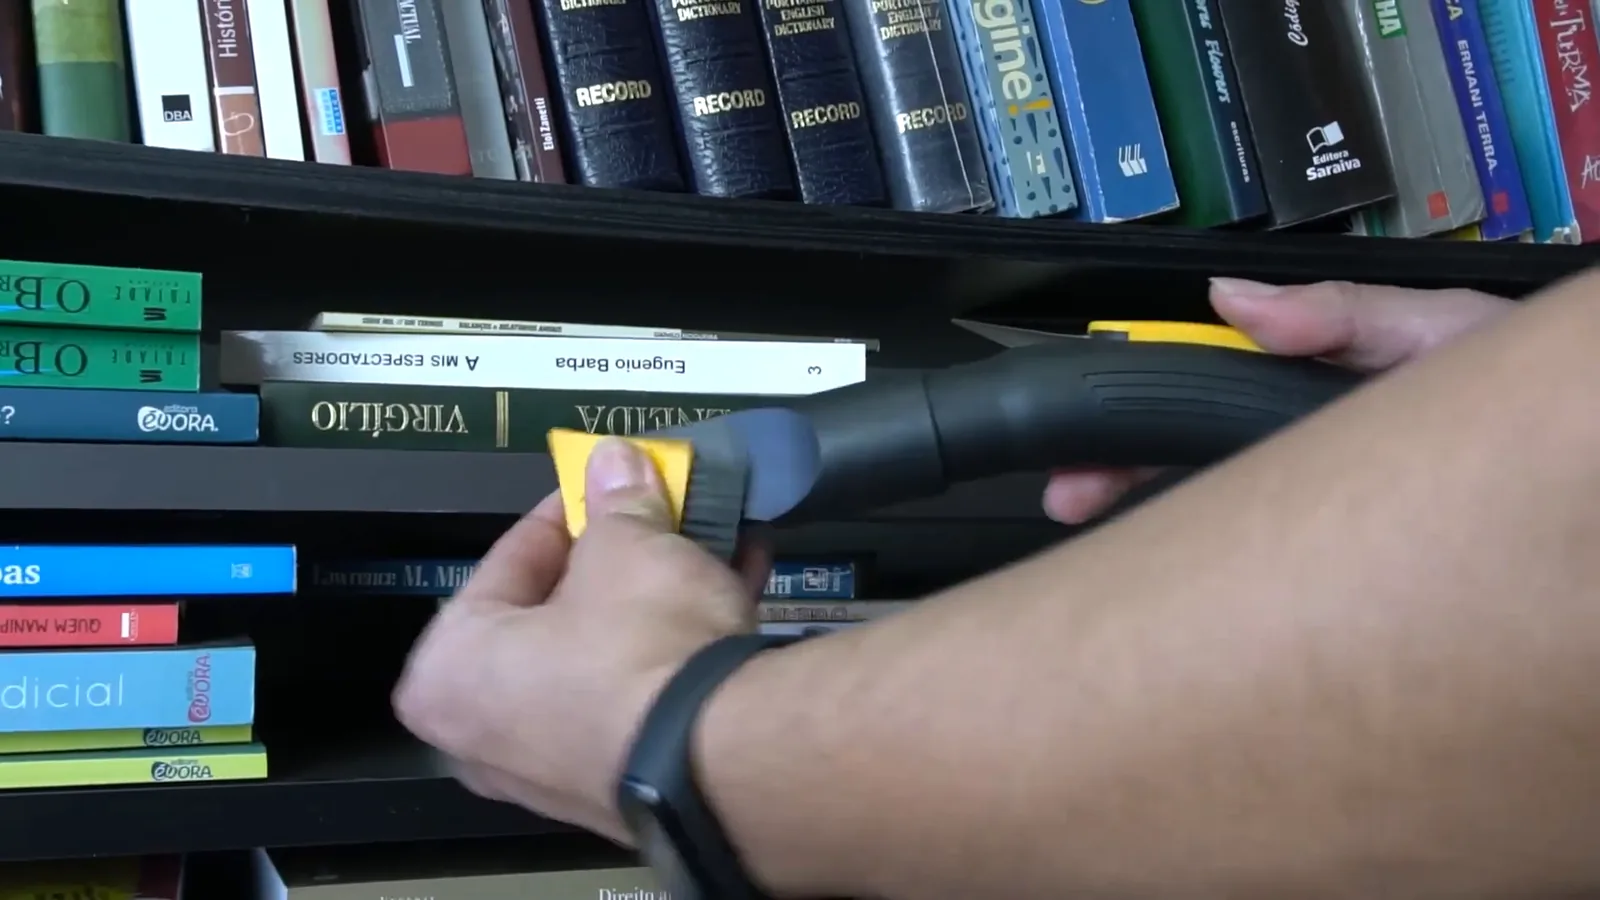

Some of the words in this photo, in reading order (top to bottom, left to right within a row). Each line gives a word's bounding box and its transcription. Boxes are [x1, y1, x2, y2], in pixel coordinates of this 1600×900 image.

[561, 0, 626, 11] DICTION
[677, 2, 741, 22] DICTIONARY
[781, 5, 825, 21] ENGLISH
[774, 17, 835, 36] DICTIONARY
[880, 19, 942, 40] DICTIONARY
[1205, 39, 1230, 104] Flowers
[576, 80, 651, 107] RECORD
[693, 89, 765, 117] RECORD
[164, 110, 192, 122] DBA
[534, 97, 551, 133] Zanetti
[791, 102, 861, 129] RECORD
[1457, 40, 1483, 107] ERNANI
[1476, 111, 1498, 173] TERRA
[897, 103, 967, 134] RECORD
[541, 134, 554, 151] Eloi
[1231, 121, 1250, 183] escrituras
[1312, 150, 1349, 165] Editora
[1306, 158, 1361, 181] Saraiva
[56, 279, 91, 314] O
[115, 285, 191, 304] TRIADE
[54, 343, 89, 377] O
[111, 349, 187, 366] TRIADE
[293, 352, 424, 367] ESPECTADORES
[431, 355, 459, 368] MIS
[465, 356, 479, 371] A
[556, 357, 609, 372] Barba
[615, 357, 686, 374] Eugenio
[311, 400, 469, 438] VIRGÍLIO
[575, 405, 731, 436] NEIDA
[0, 563, 41, 585] as
[403, 564, 429, 587] M.
[54, 618, 102, 634] QUEM
